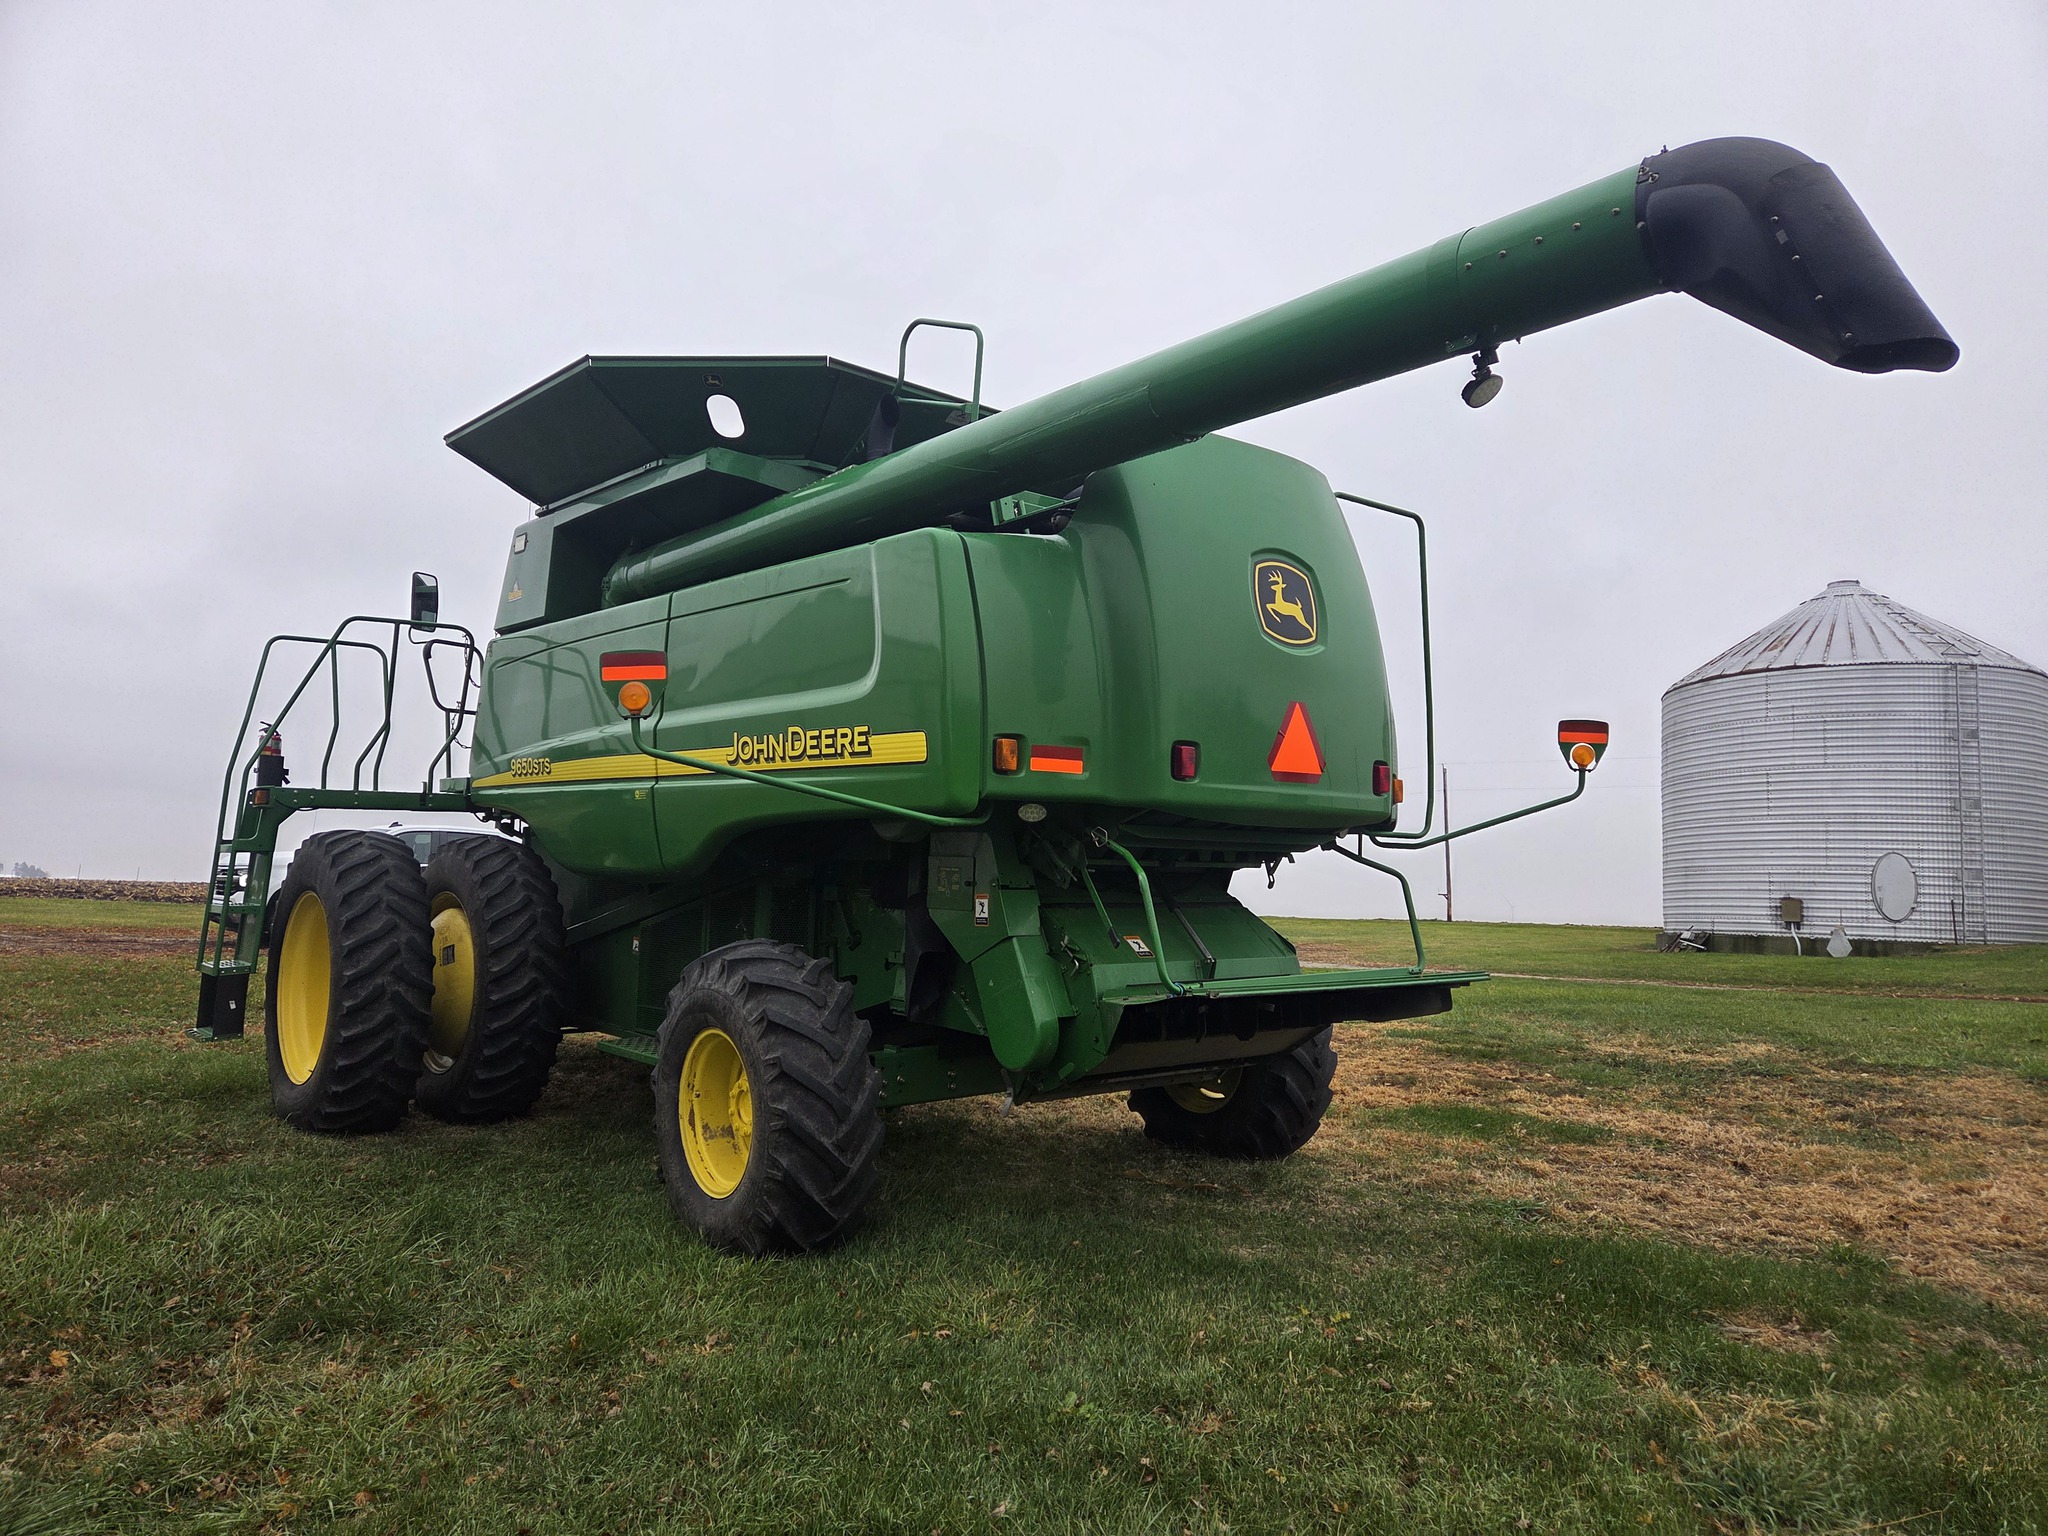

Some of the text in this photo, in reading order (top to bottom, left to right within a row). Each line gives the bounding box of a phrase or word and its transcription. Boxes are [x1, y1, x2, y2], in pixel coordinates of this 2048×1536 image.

[726, 725, 871, 763] JOHN DEERE
[511, 757, 551, 776] 9650STS
